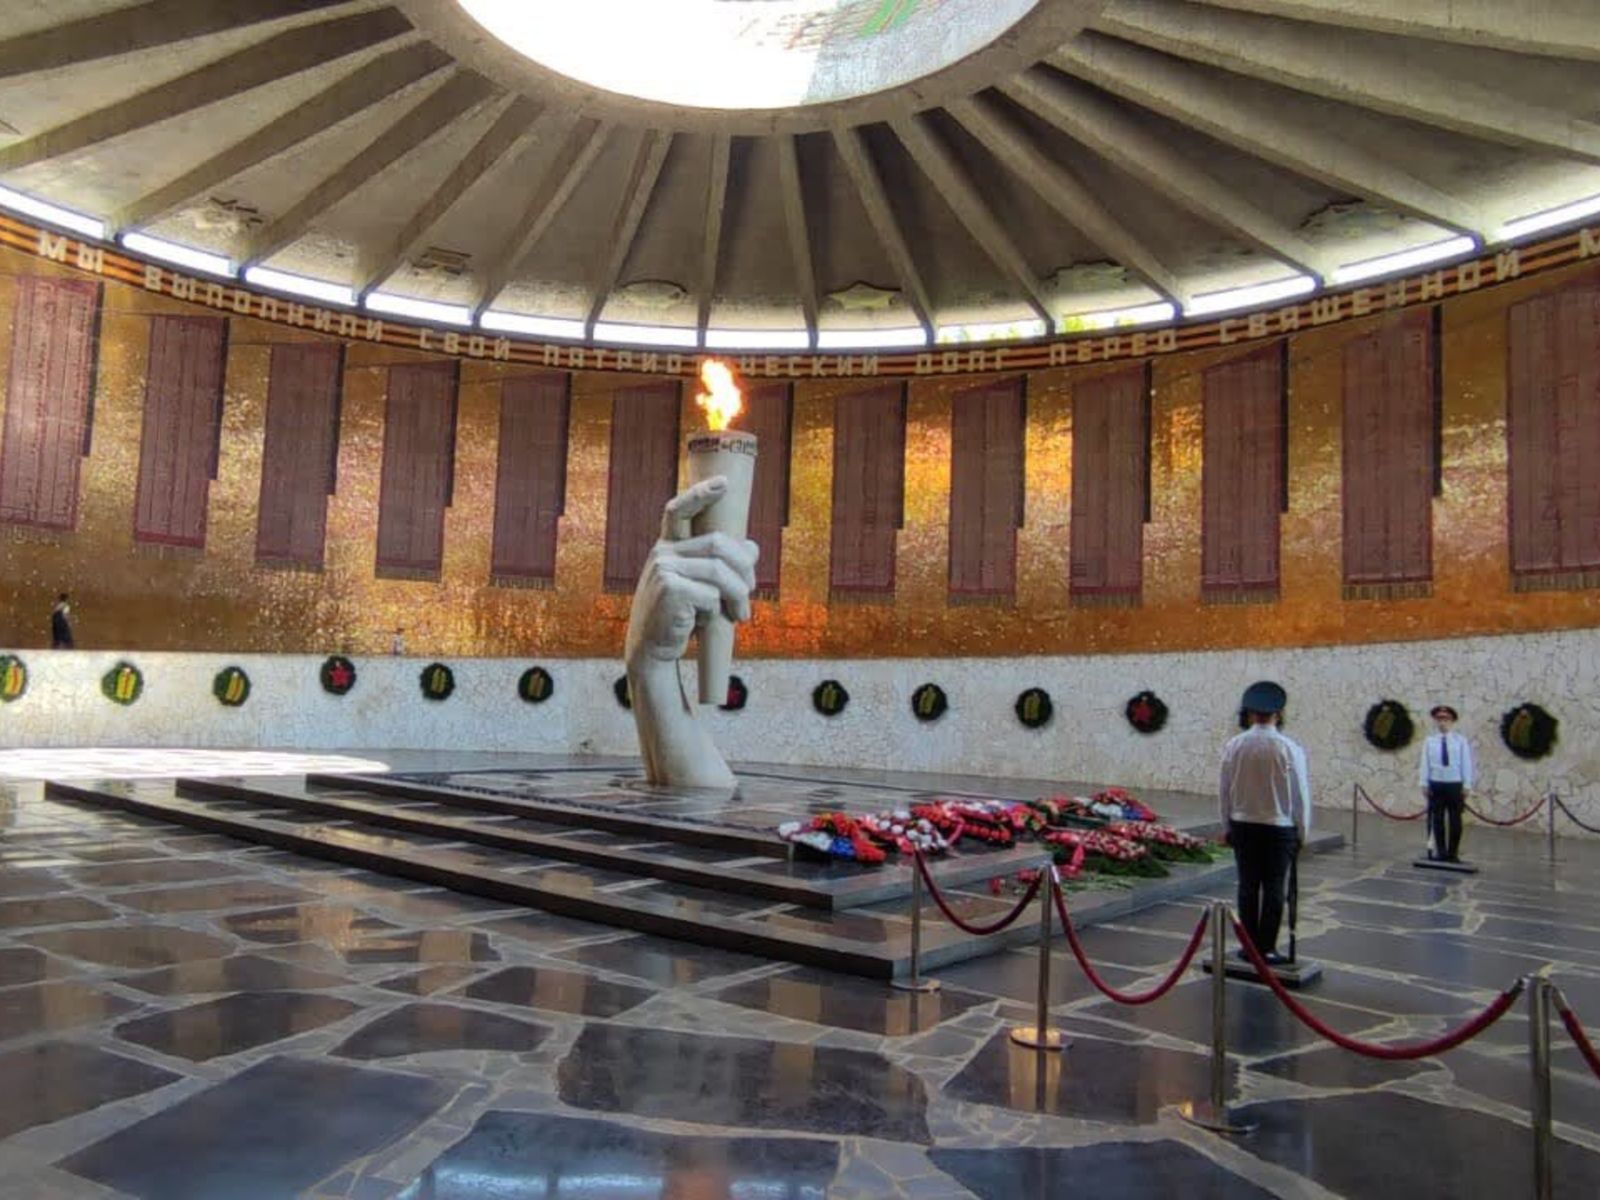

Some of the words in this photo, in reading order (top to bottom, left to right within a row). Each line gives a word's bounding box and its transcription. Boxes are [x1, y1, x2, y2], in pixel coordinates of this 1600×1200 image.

[38, 230, 104, 273] МЫ
[145, 264, 384, 341] ВЫПОЛНИЛИ
[419, 327, 511, 361] СВОЙ
[543, 344, 878, 377] ПАТРИОТЧЕСКИЙ
[914, 348, 1009, 374] ДОЛГ
[1051, 329, 1178, 365] ПЕРЕД
